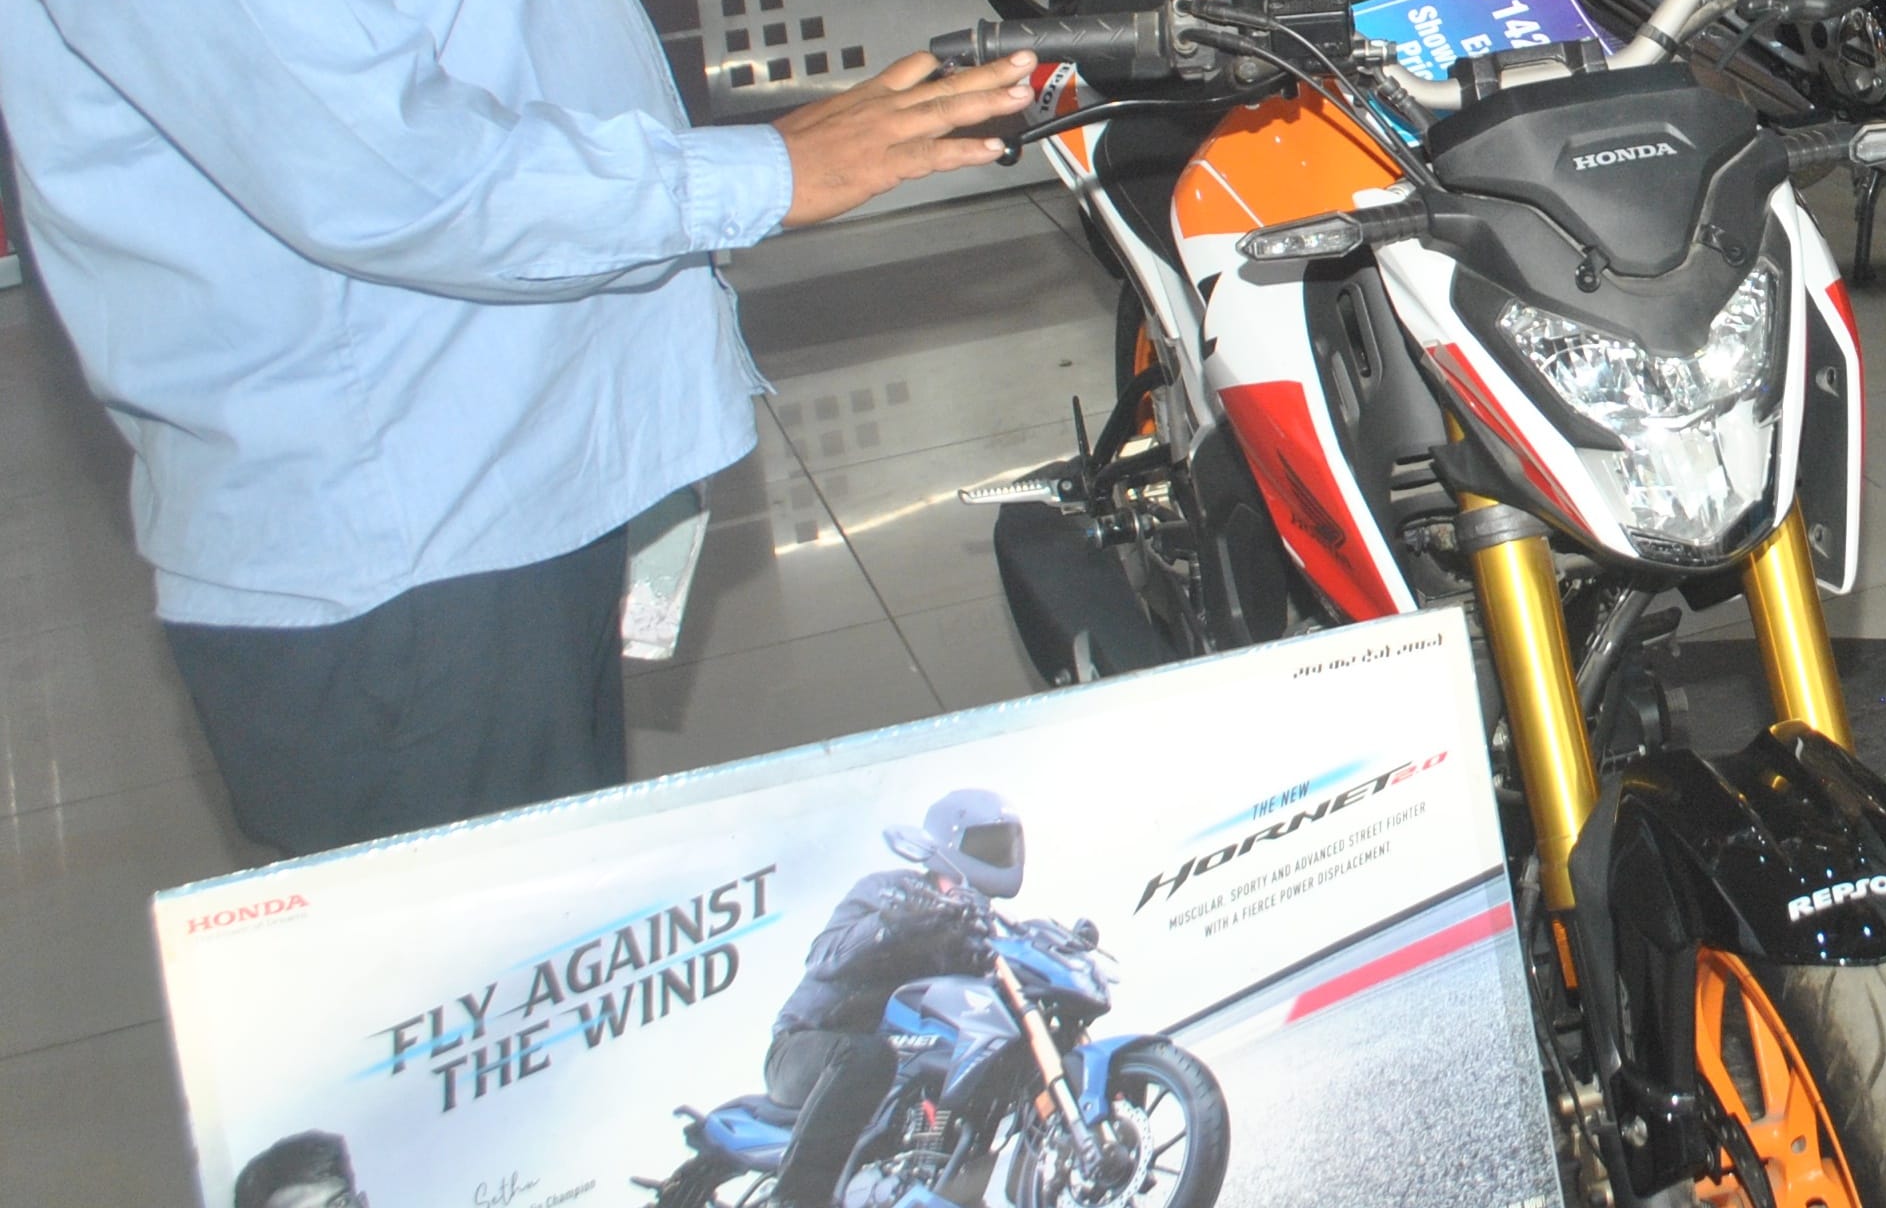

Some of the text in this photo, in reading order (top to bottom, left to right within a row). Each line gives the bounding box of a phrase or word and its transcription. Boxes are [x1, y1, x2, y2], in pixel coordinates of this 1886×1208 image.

[1572, 142, 1678, 171] HONDA
[1133, 750, 1448, 916] HORNET 2.0
[1252, 780, 1311, 821] THE NEW
[1204, 839, 1391, 938] WITH A FIERCE POWER DISPLACEMENT
[1230, 875, 1269, 903] SPORTY
[1271, 863, 1292, 883] AND
[1294, 840, 1345, 872] ADVANCED
[1348, 820, 1384, 848] STREET
[1386, 800, 1427, 830] FIGHTER
[187, 893, 310, 934] HONDA
[366, 863, 777, 1075] FLY AGAINST
[431, 941, 740, 1114] THE WIND
